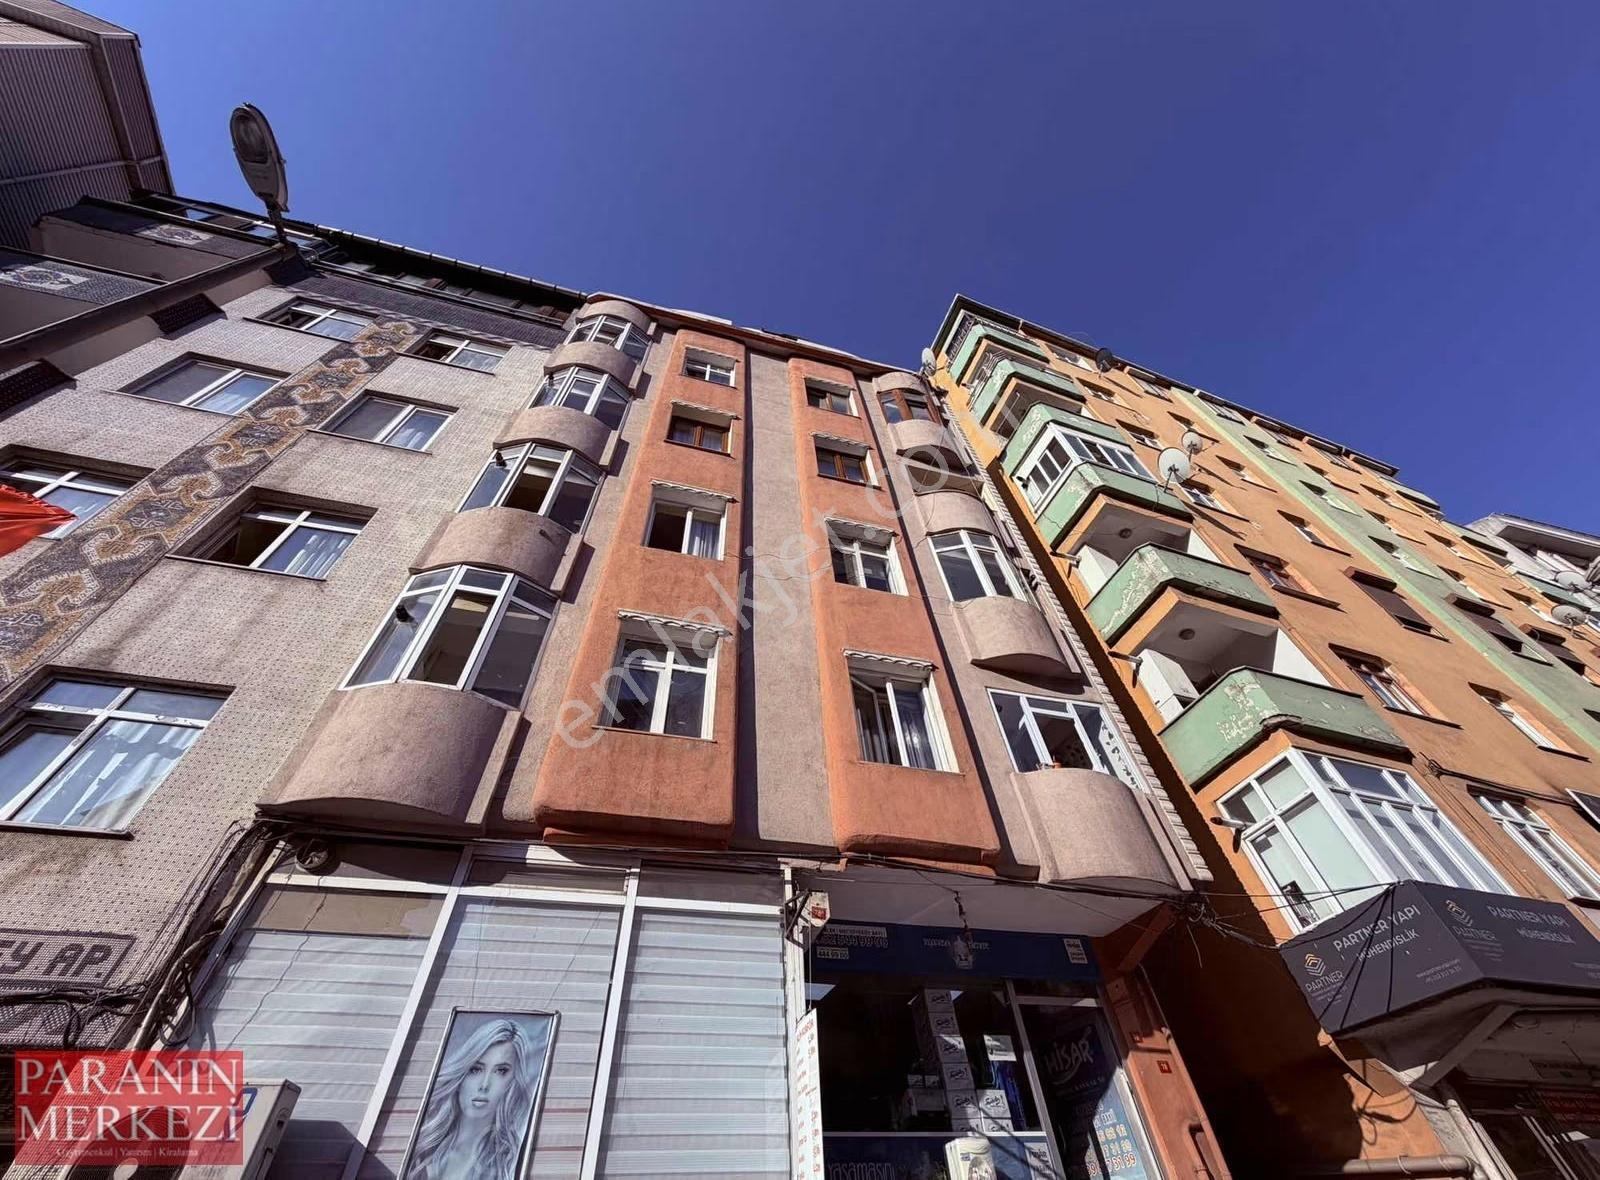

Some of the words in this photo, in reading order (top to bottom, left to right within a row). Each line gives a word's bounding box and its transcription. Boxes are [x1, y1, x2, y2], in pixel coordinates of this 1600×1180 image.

[1333, 919, 1390, 951] PARTNER
[1387, 904, 1421, 925] YAPI
[1305, 970, 1345, 992] PARTNER
